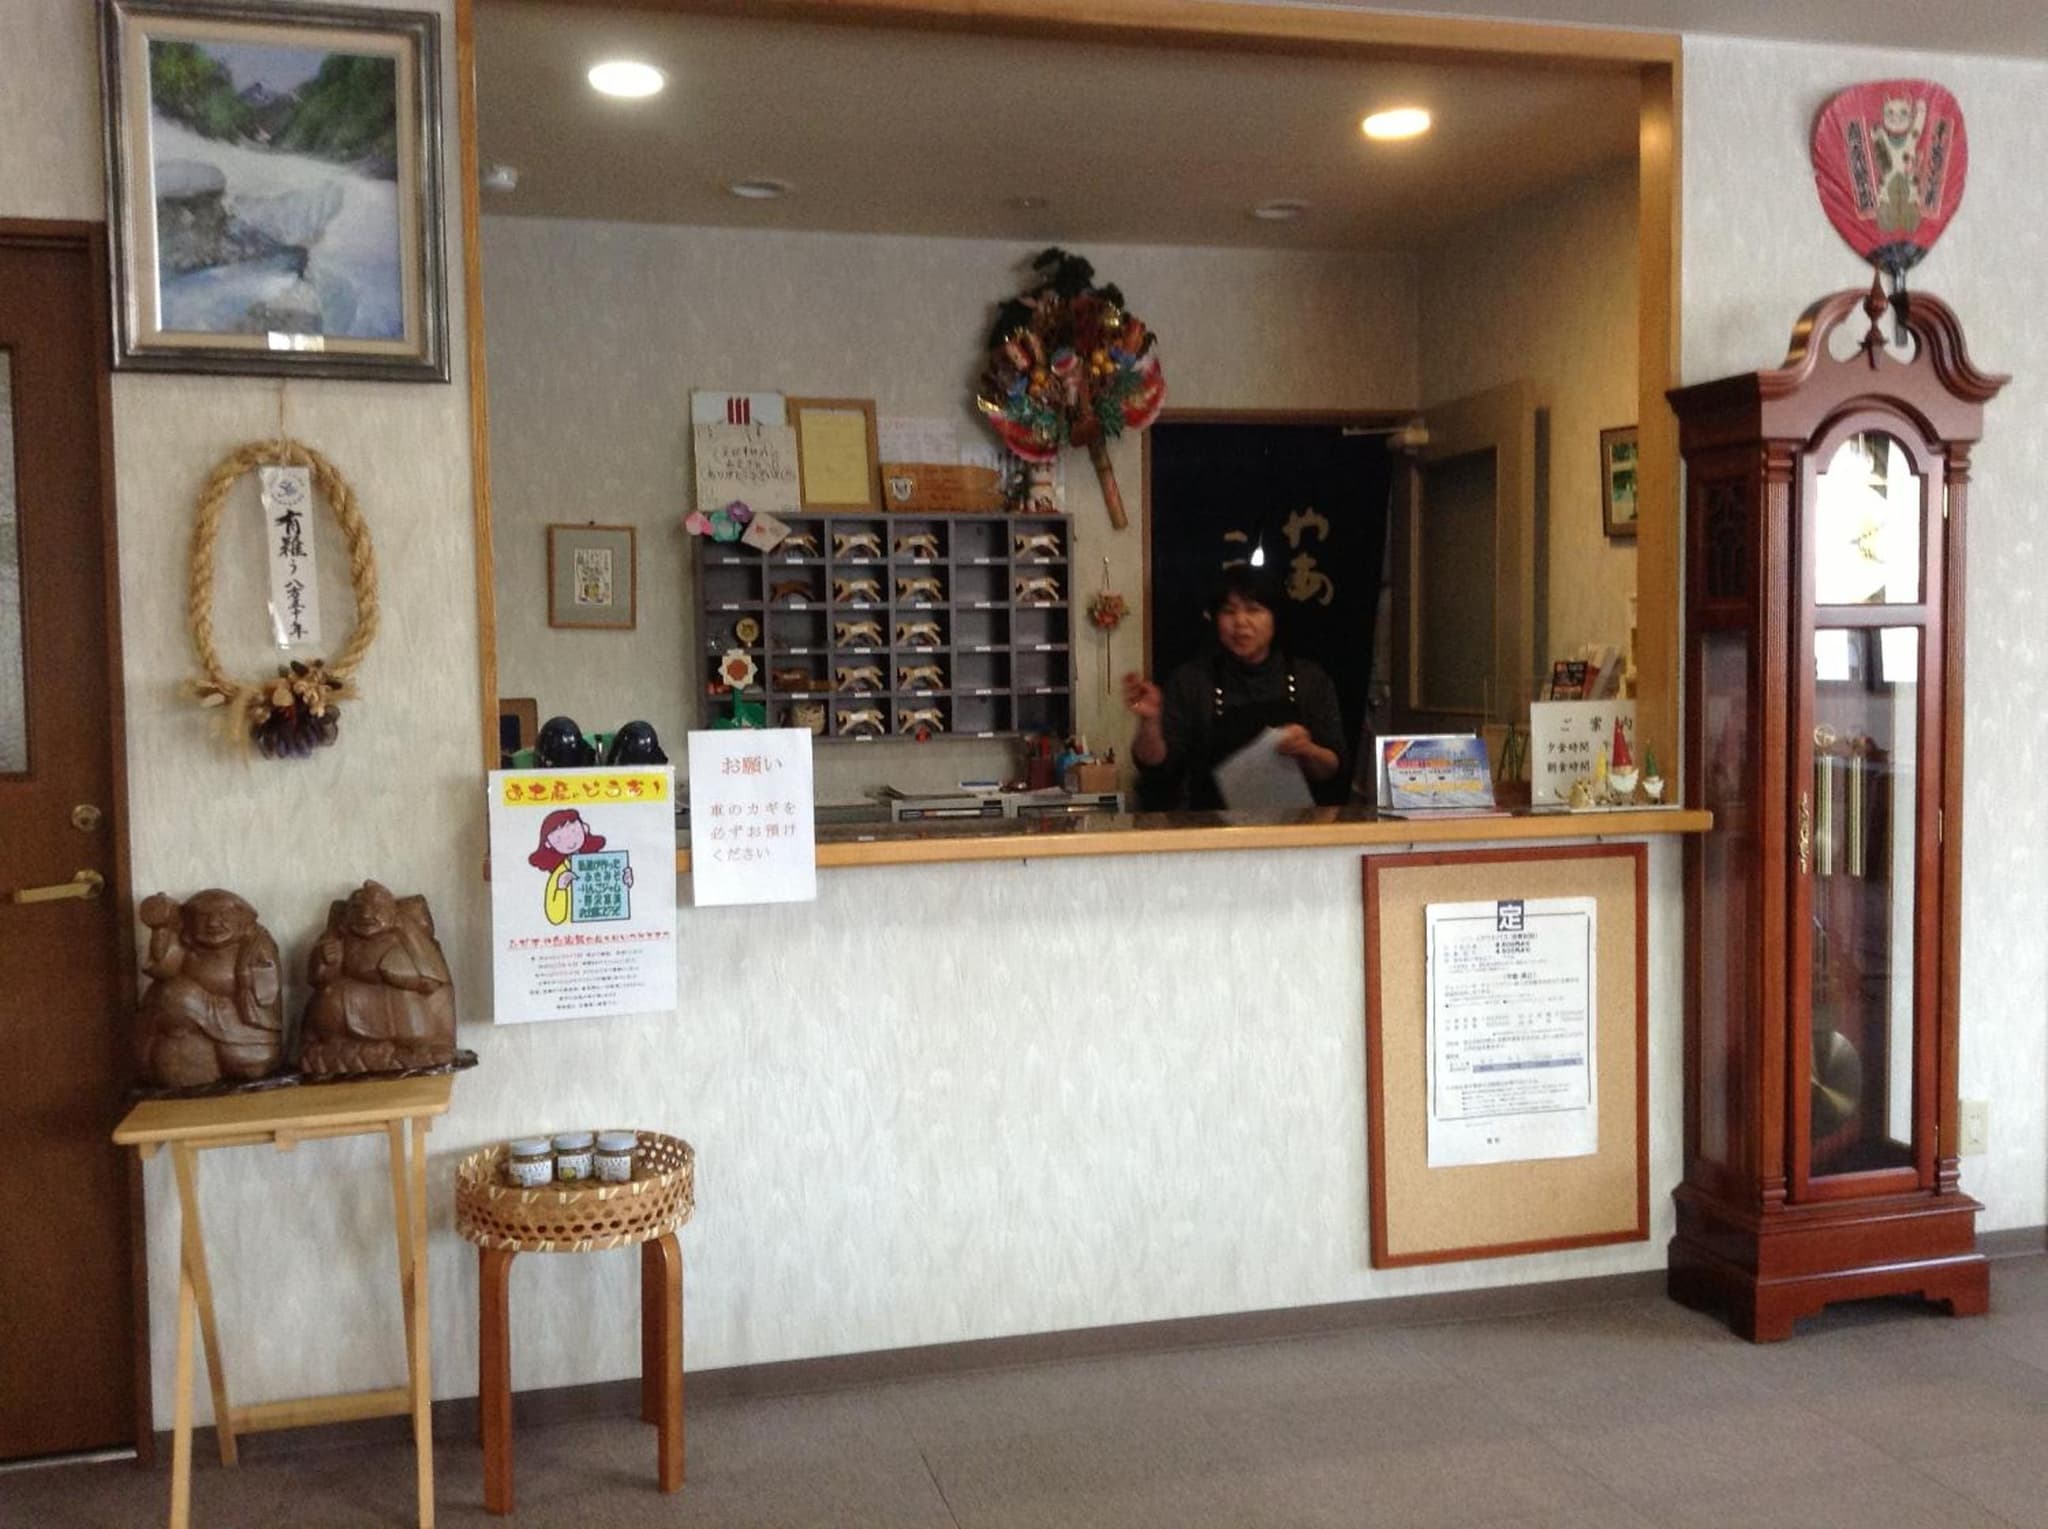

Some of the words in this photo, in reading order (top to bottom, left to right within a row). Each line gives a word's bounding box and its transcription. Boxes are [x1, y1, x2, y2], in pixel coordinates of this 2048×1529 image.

[721, 756, 783, 775] お願い
[1547, 760, 1590, 774] 朝食時間
[710, 801, 796, 817] 車のカギを
[710, 823, 796, 840] 必ずお預け
[713, 847, 770, 861] ください
[1499, 904, 1522, 930] 定
